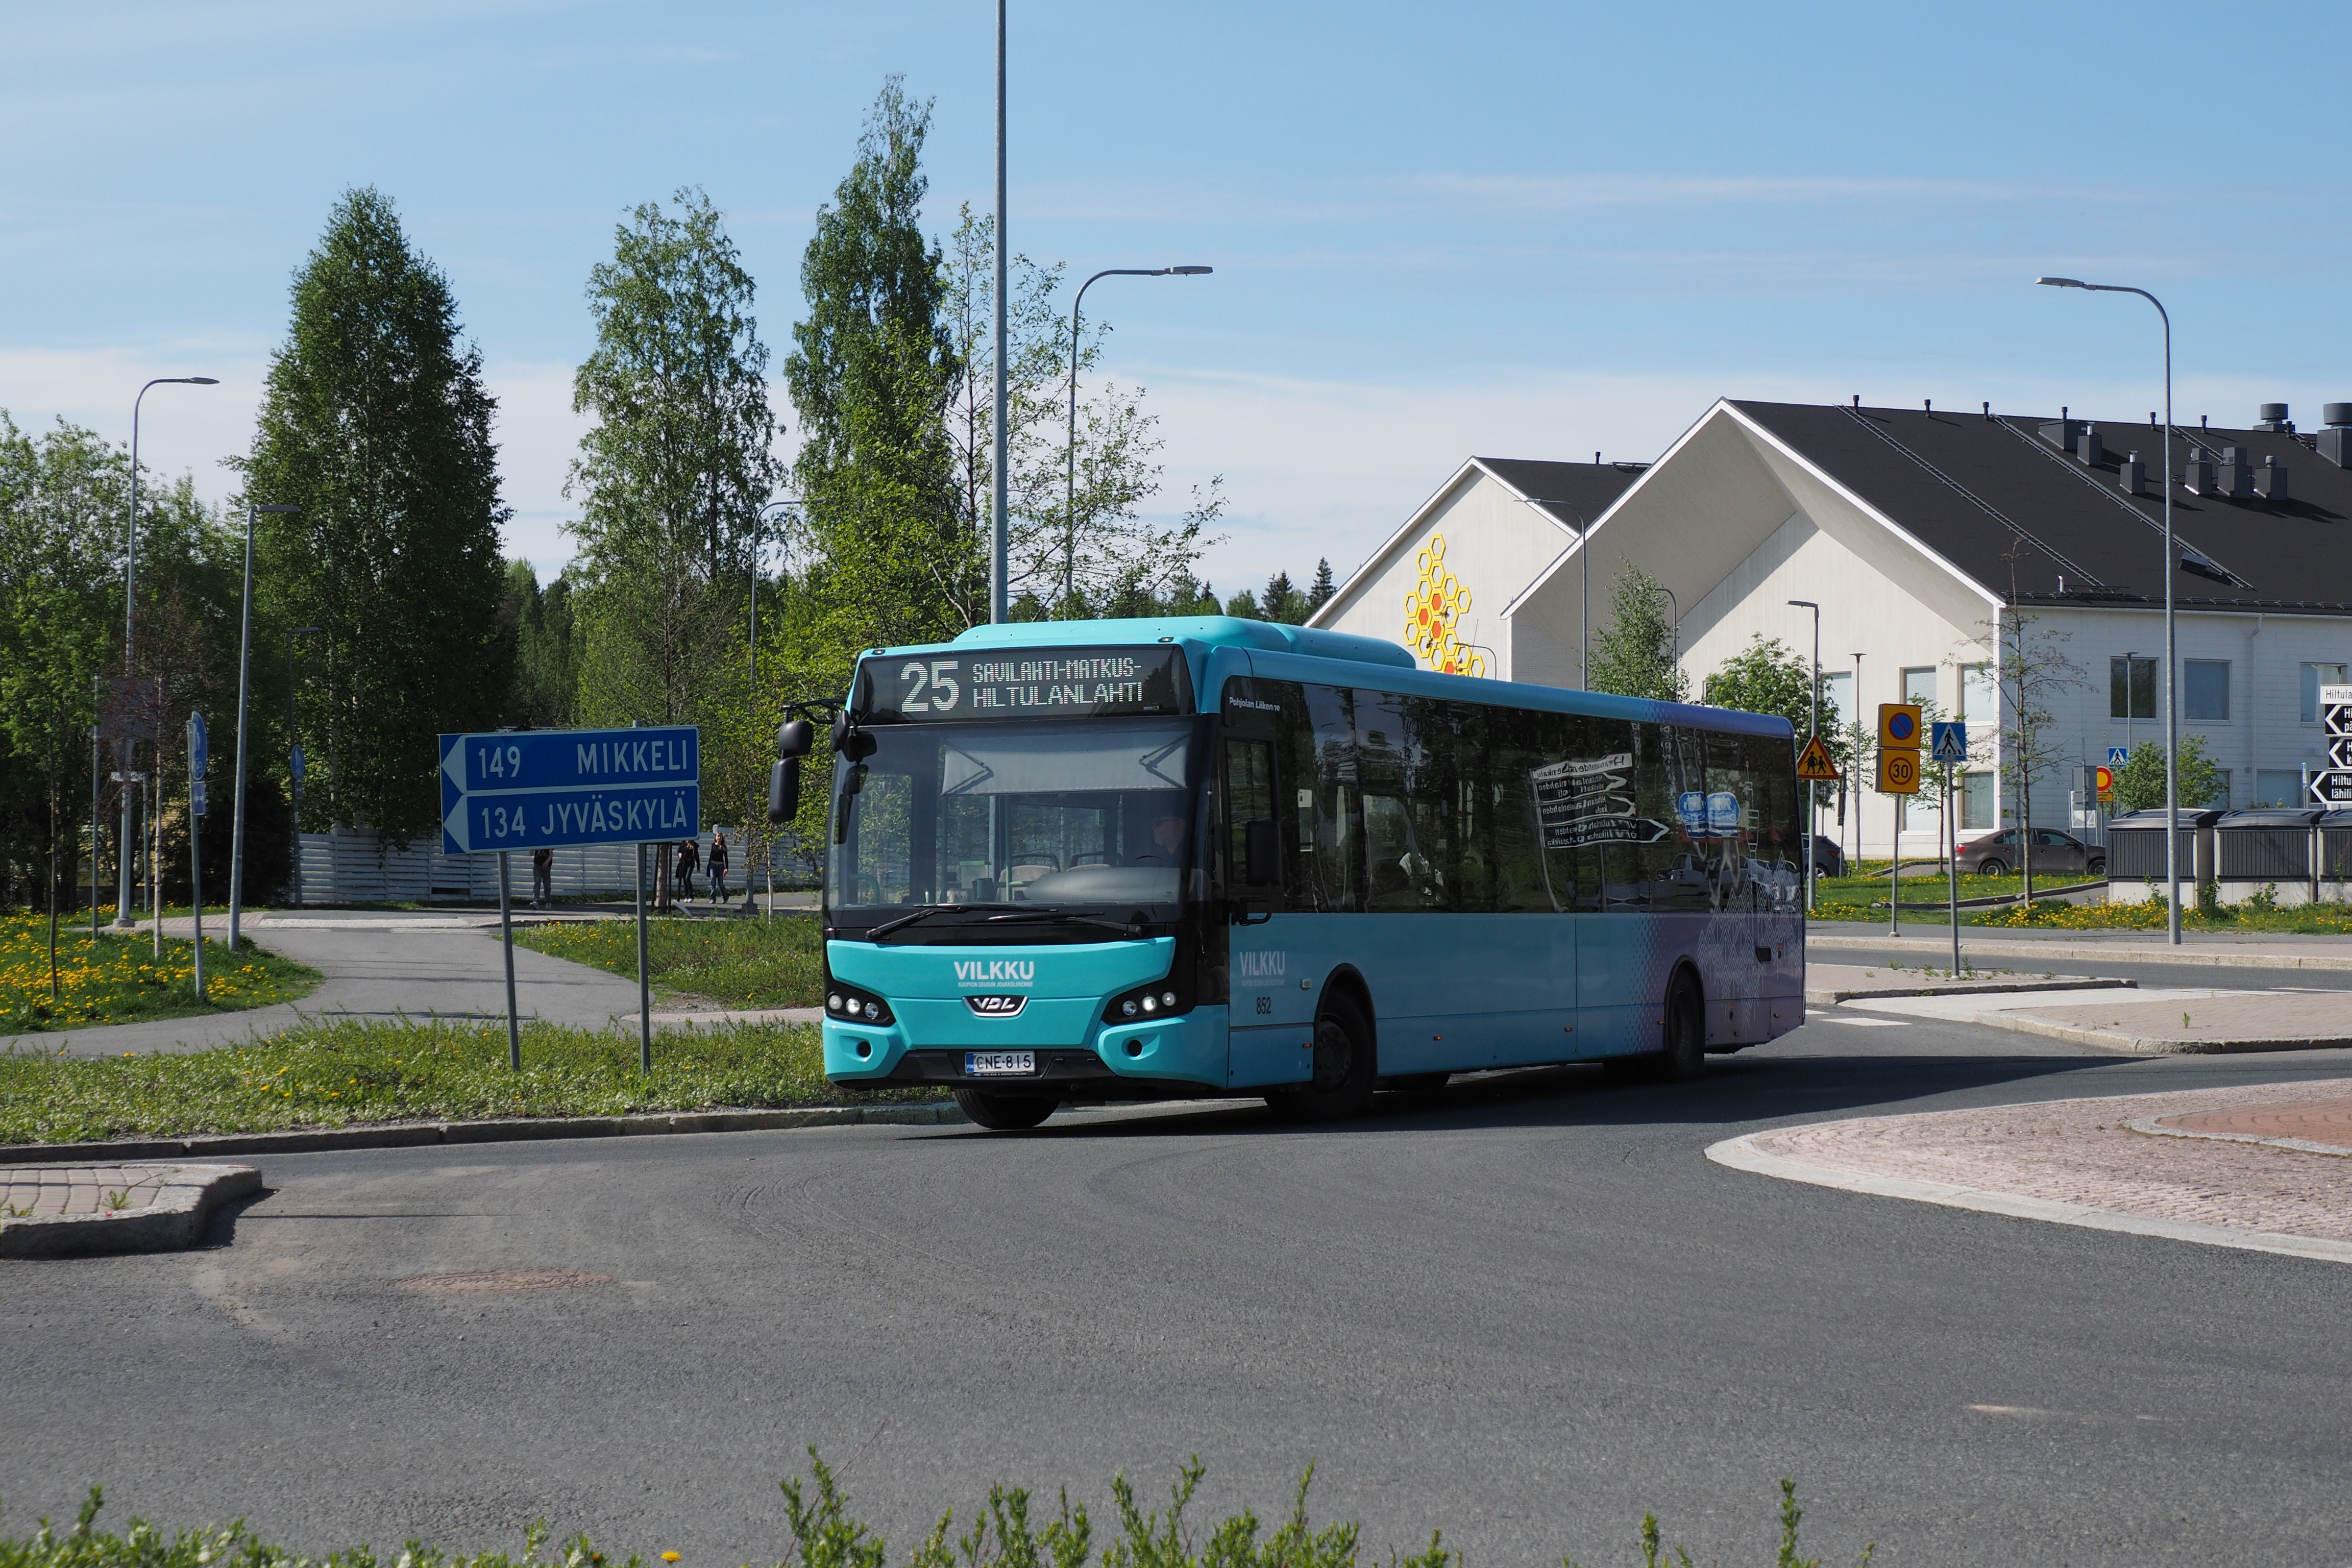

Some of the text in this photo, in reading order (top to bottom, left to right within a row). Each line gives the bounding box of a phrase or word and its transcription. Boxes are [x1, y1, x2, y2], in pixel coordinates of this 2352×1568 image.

[901, 661, 959, 712] 25
[973, 682, 1143, 707] HILTULANLAHTI
[1229, 697, 1281, 712] Pohjolan Liikenne
[478, 740, 687, 779] 149 MIKKELI
[1893, 764, 1908, 778] 30
[481, 791, 688, 839] 134 JYVÄSKYLÄ
[953, 961, 1035, 980] VILKKU
[1239, 951, 1285, 976] VILKKU
[973, 998, 1015, 1010] VDL
[1256, 996, 1271, 1015] 852
[976, 1055, 1032, 1070] CNE-815
